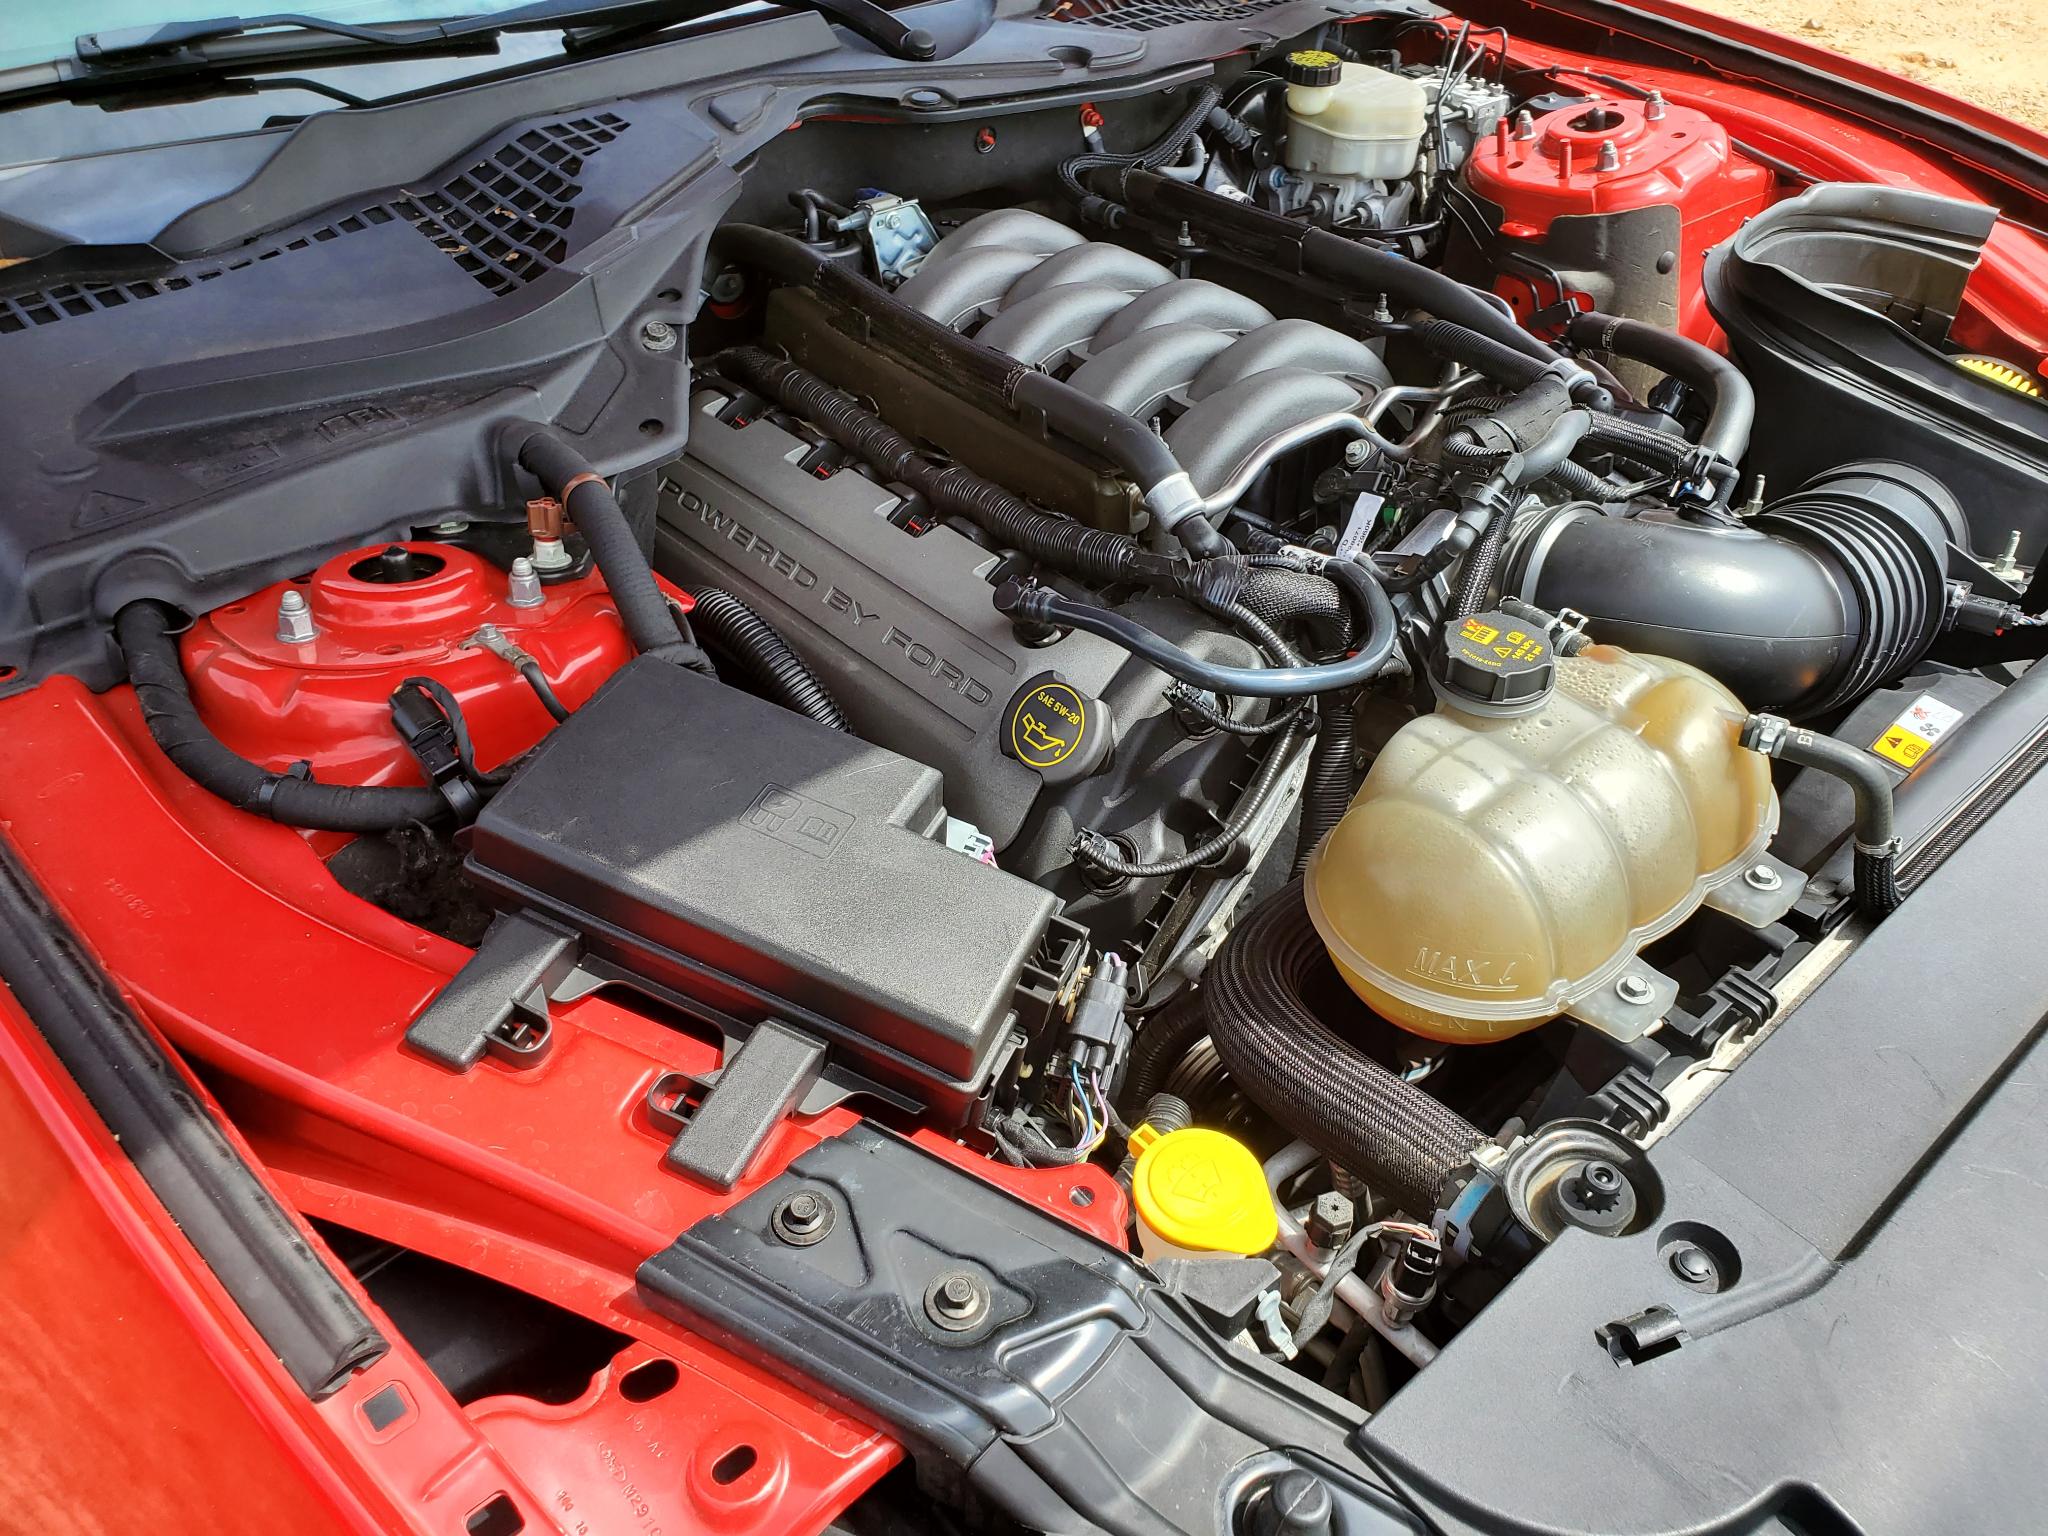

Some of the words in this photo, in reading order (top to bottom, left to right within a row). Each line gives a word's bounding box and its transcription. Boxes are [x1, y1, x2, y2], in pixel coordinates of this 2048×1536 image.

[656, 475, 818, 593] POWERED
[822, 585, 881, 627] BY
[881, 624, 994, 707] FORD
[1037, 691, 1056, 708] SAE
[1053, 702, 1081, 726] 5W-20
[1413, 947, 1491, 984] MAX
